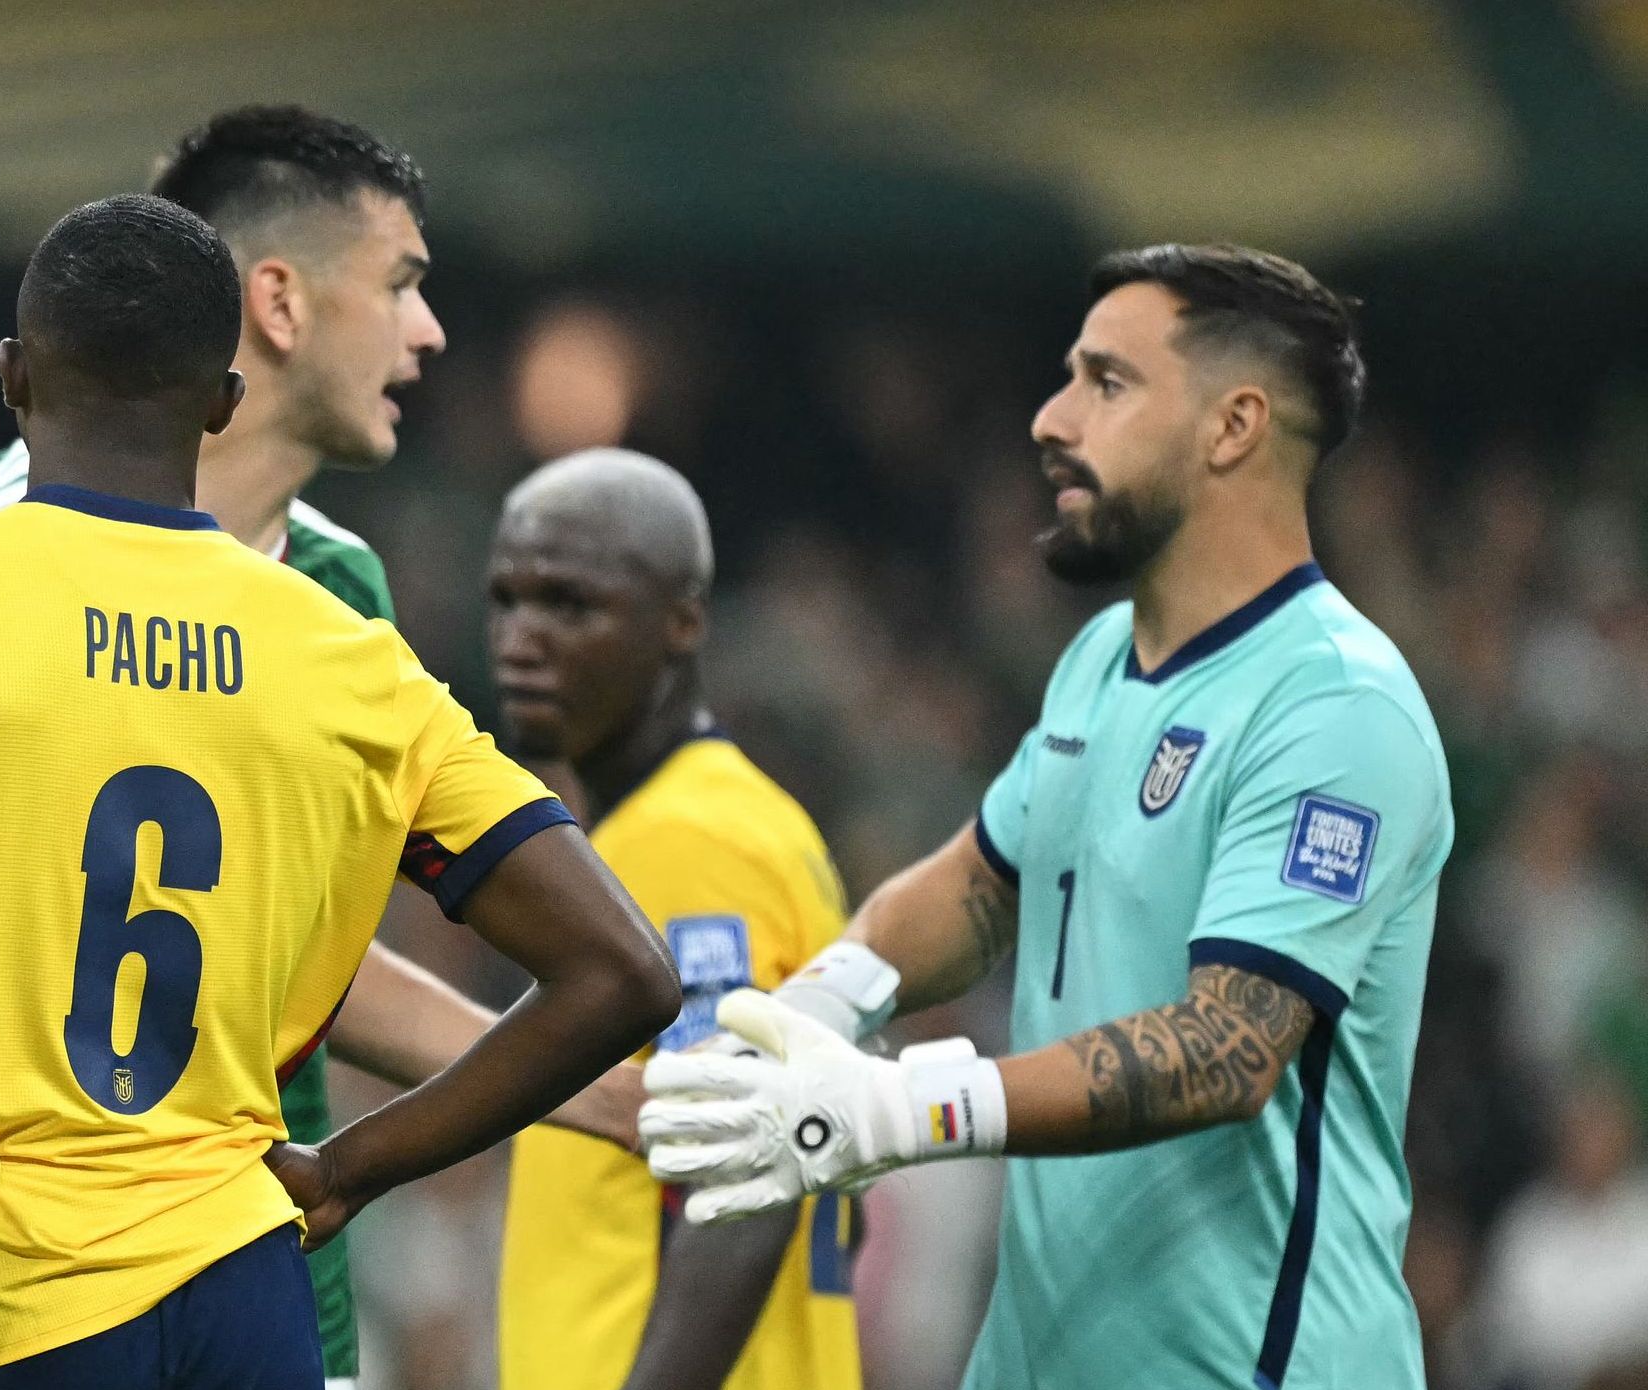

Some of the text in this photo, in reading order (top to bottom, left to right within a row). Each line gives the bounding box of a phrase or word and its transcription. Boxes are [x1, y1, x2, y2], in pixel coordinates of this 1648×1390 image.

[84, 606, 244, 696] PACHO
[1305, 826, 1362, 859] UNITES
[63, 764, 223, 1116] 6
[1051, 870, 1075, 1001] 1
